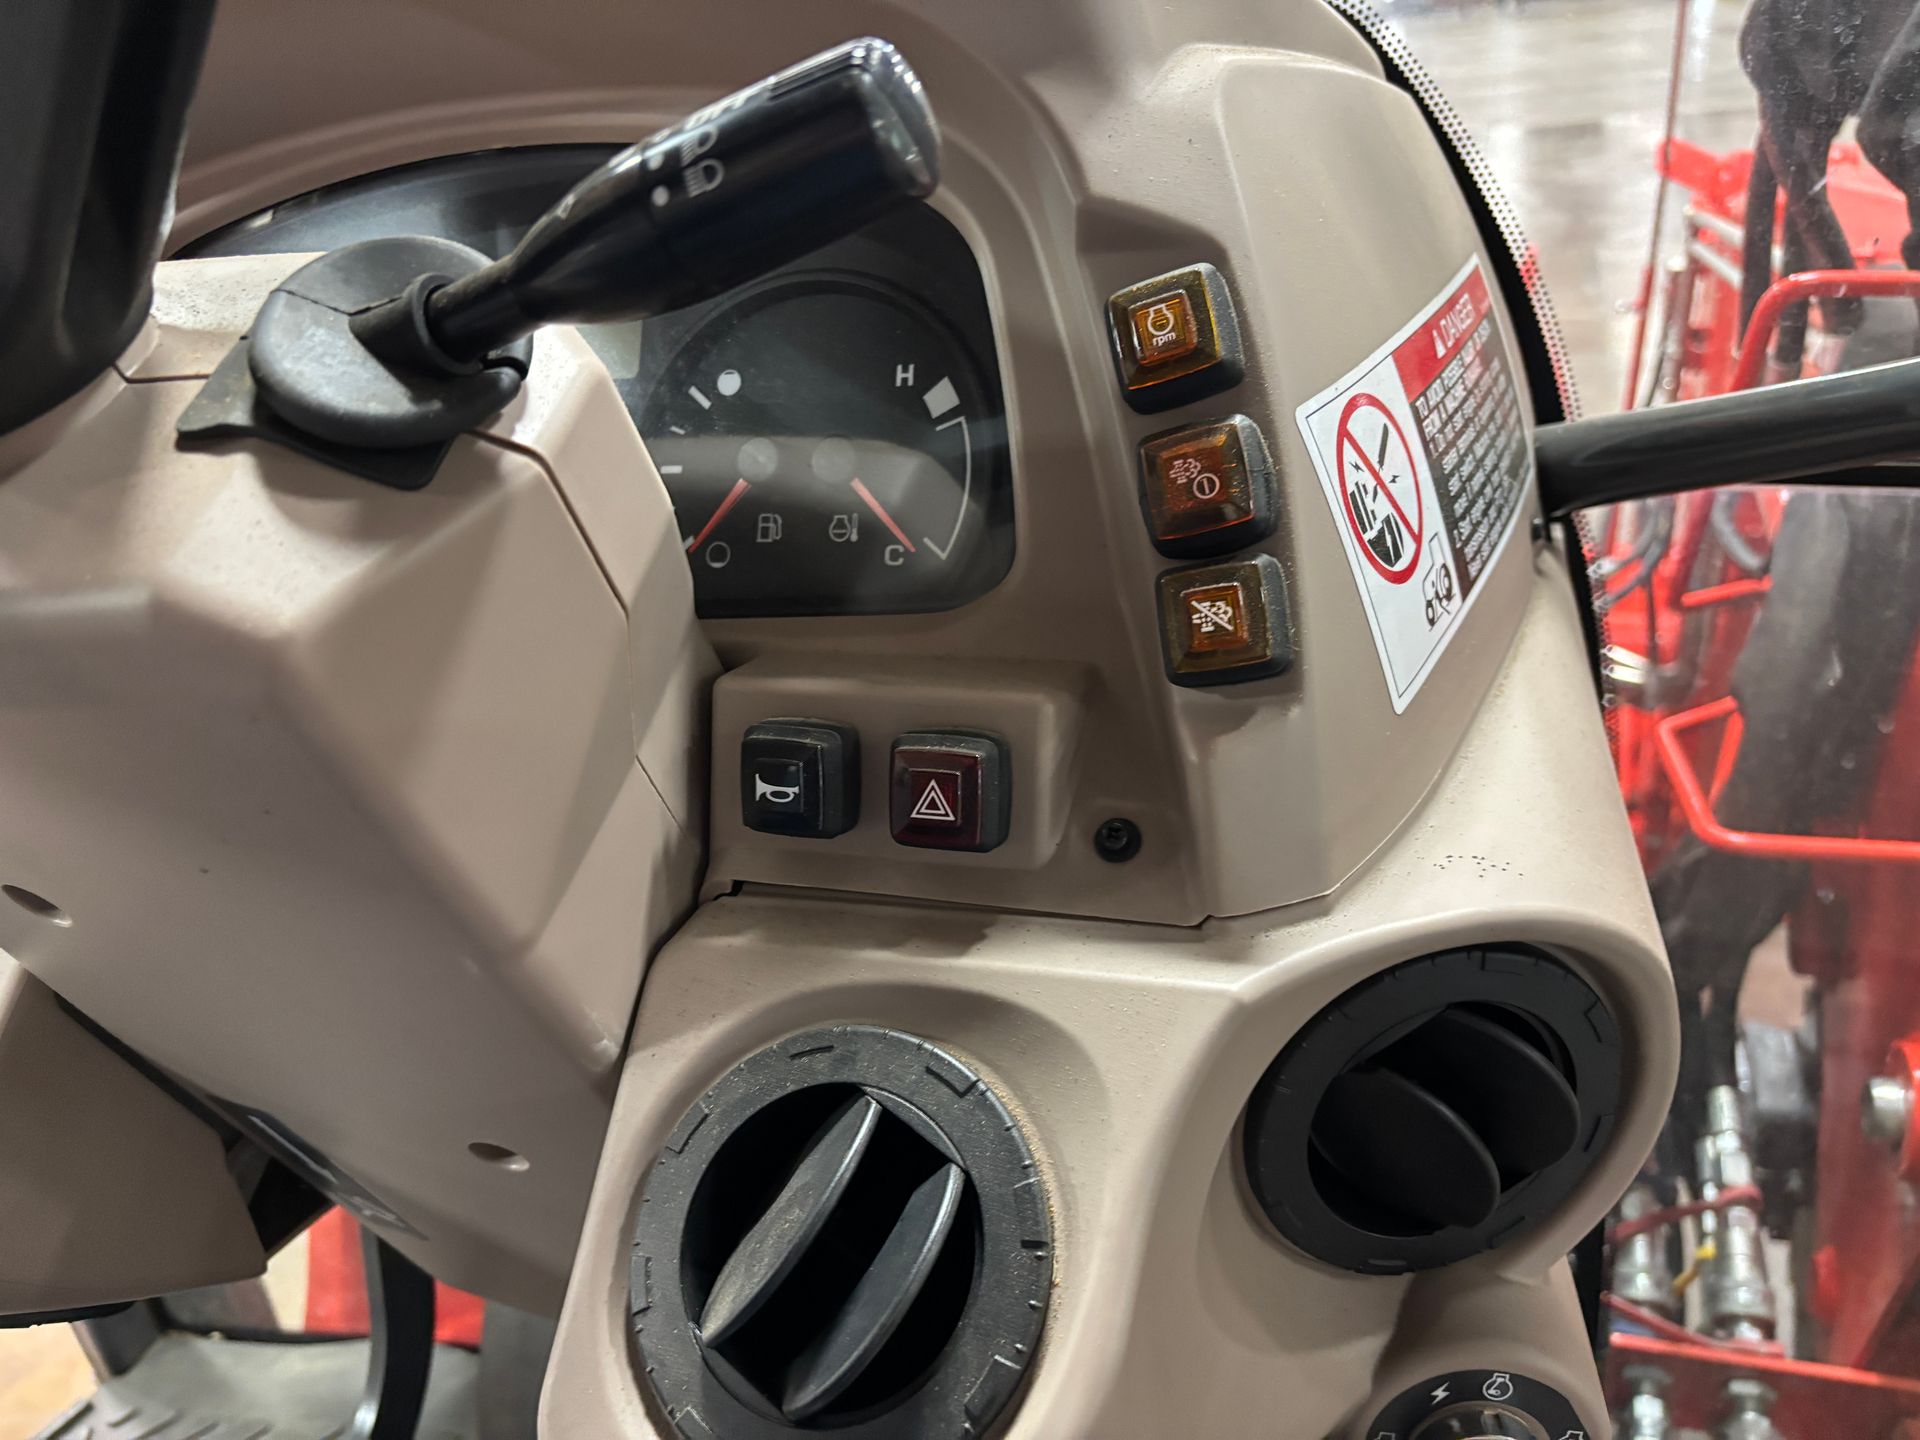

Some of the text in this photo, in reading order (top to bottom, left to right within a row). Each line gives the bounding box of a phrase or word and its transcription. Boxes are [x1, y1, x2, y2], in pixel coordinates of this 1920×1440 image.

[1440, 292, 1476, 349] DANGER
[1152, 332, 1177, 347] rpm
[895, 363, 915, 387] H
[884, 544, 905, 566] C
